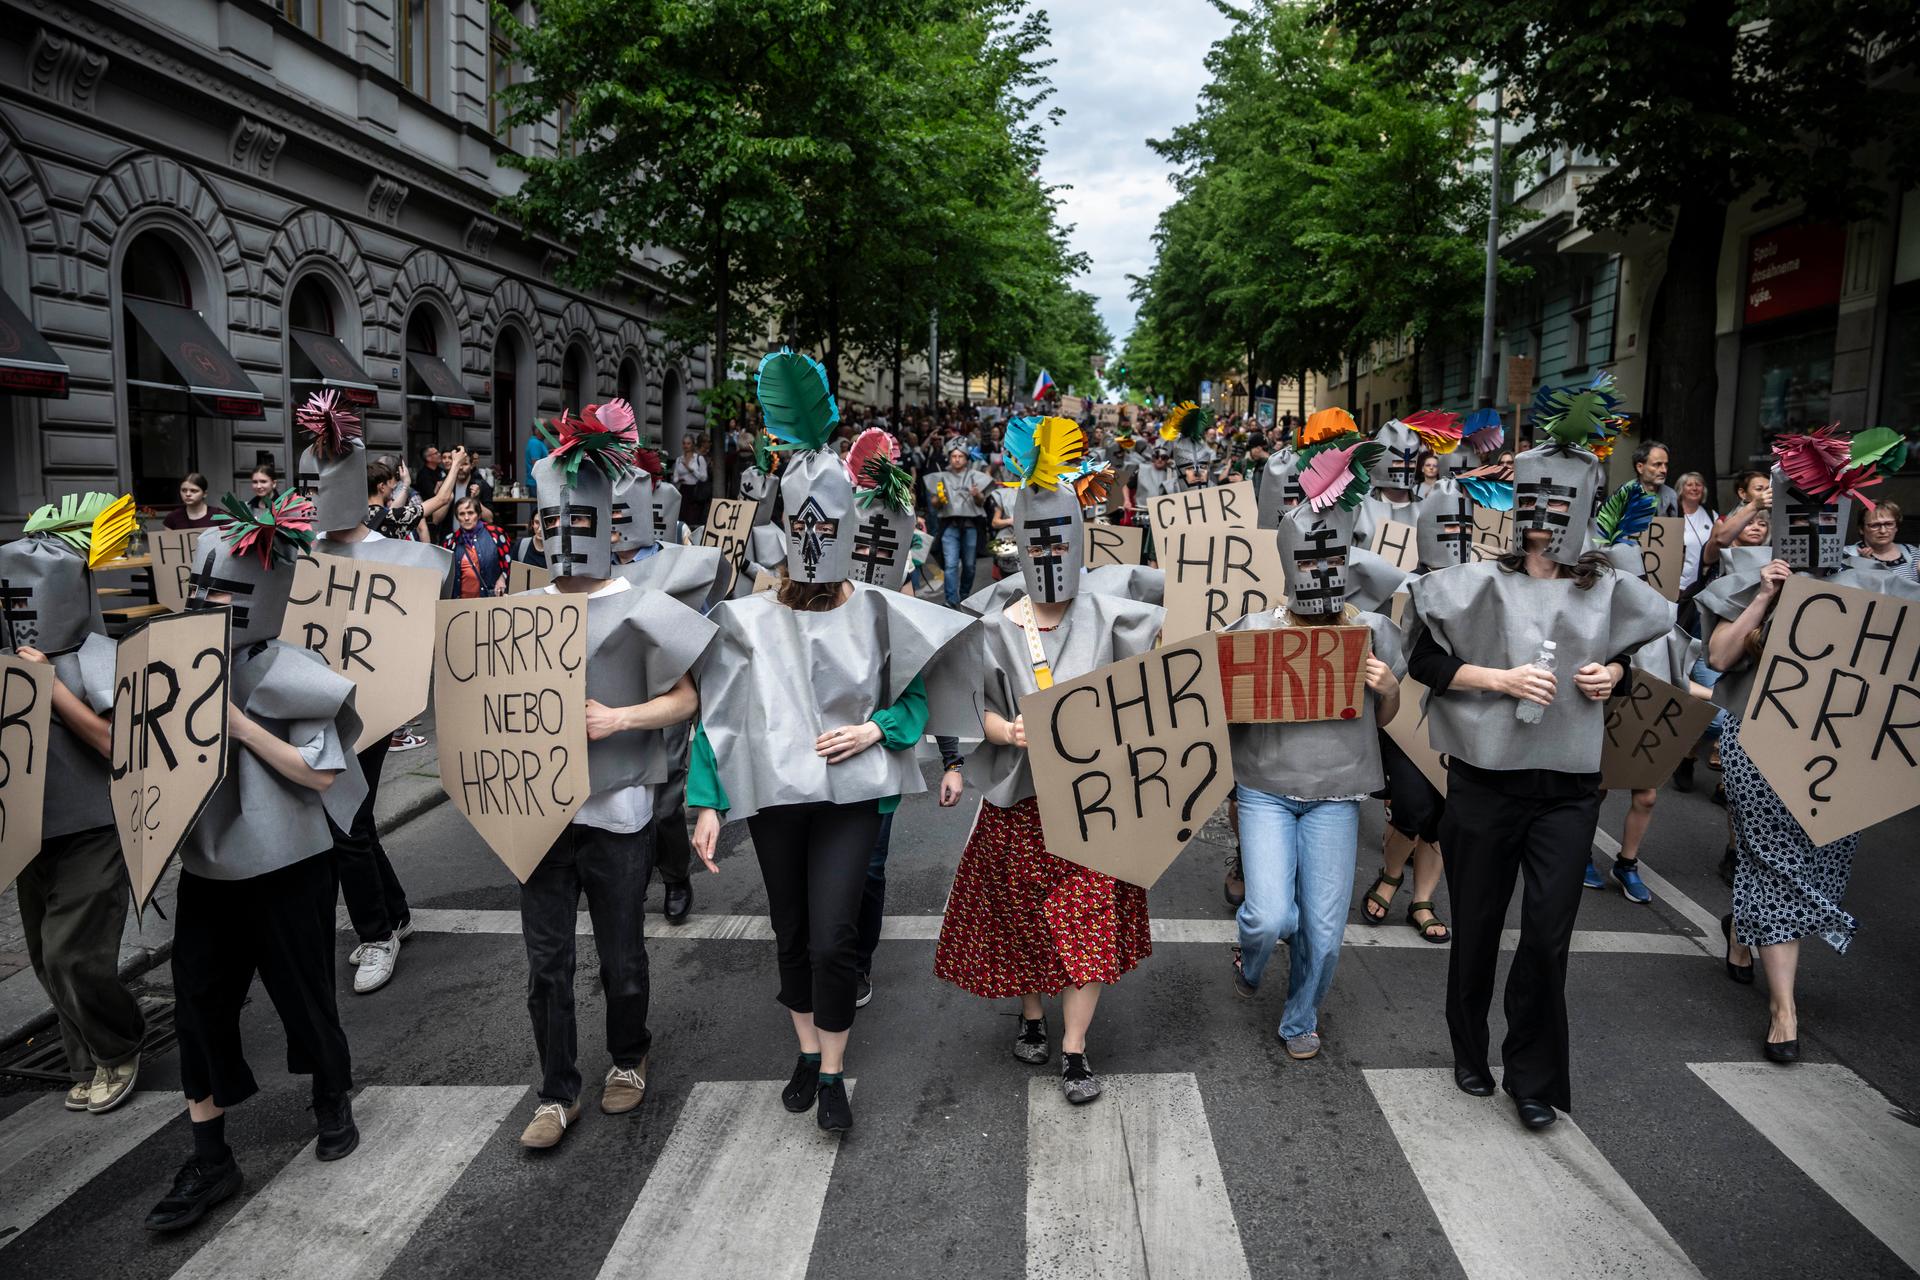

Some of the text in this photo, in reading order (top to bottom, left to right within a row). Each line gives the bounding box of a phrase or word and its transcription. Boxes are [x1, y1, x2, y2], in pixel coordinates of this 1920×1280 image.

[713, 501, 742, 530] CH
[1157, 488, 1242, 529] CHR
[288, 555, 408, 616] CHR
[1177, 533, 1261, 586] HR
[303, 622, 376, 673] RR
[445, 605, 582, 684] CHRRR?
[1788, 593, 1920, 682] CH
[1050, 648, 1209, 765] CHR
[1217, 629, 1369, 720] HRR!
[112, 648, 226, 781] CHR?
[484, 688, 563, 736] NEBO
[1751, 655, 1920, 768] RRR
[460, 746, 574, 816] HRRR?
[1071, 741, 1218, 842] RR?
[1804, 755, 1838, 817] ?
